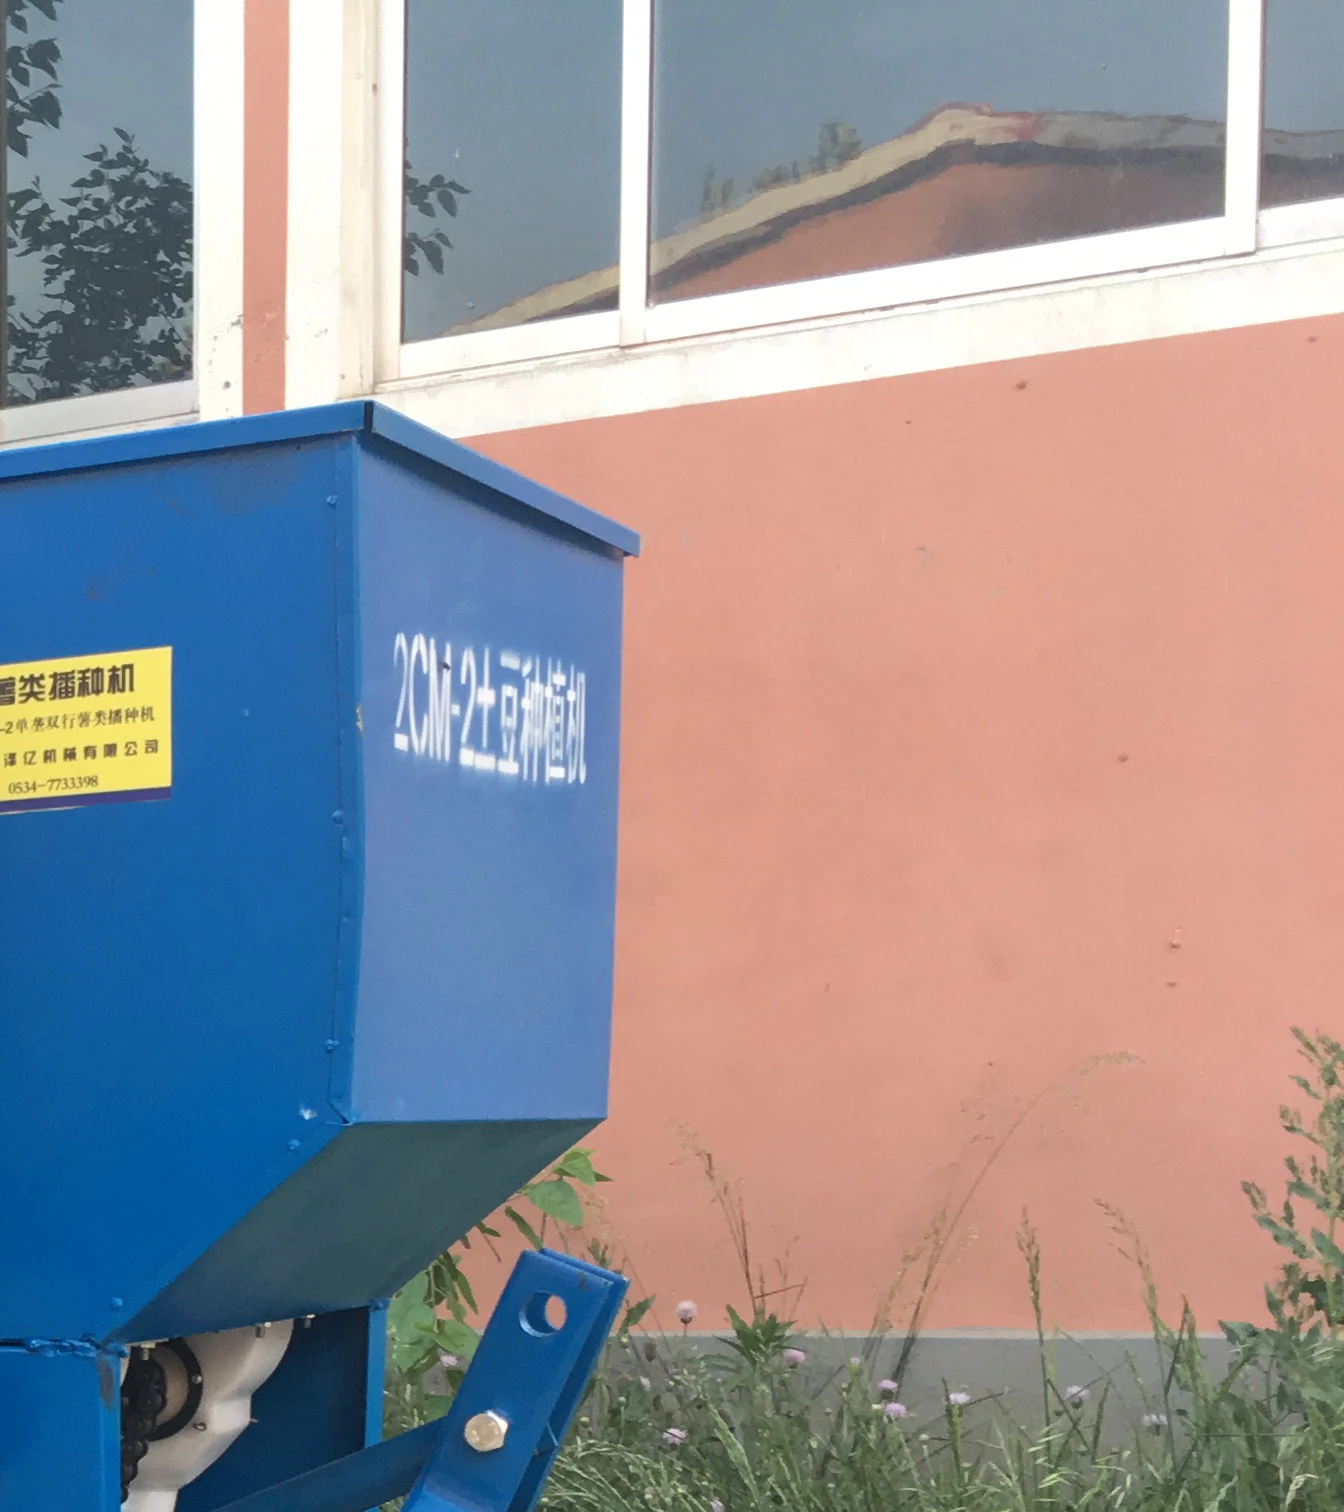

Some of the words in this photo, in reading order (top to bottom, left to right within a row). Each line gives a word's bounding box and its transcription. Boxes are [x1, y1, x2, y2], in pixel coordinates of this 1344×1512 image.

[393, 632, 587, 785] 2CM-2土豆种植机
